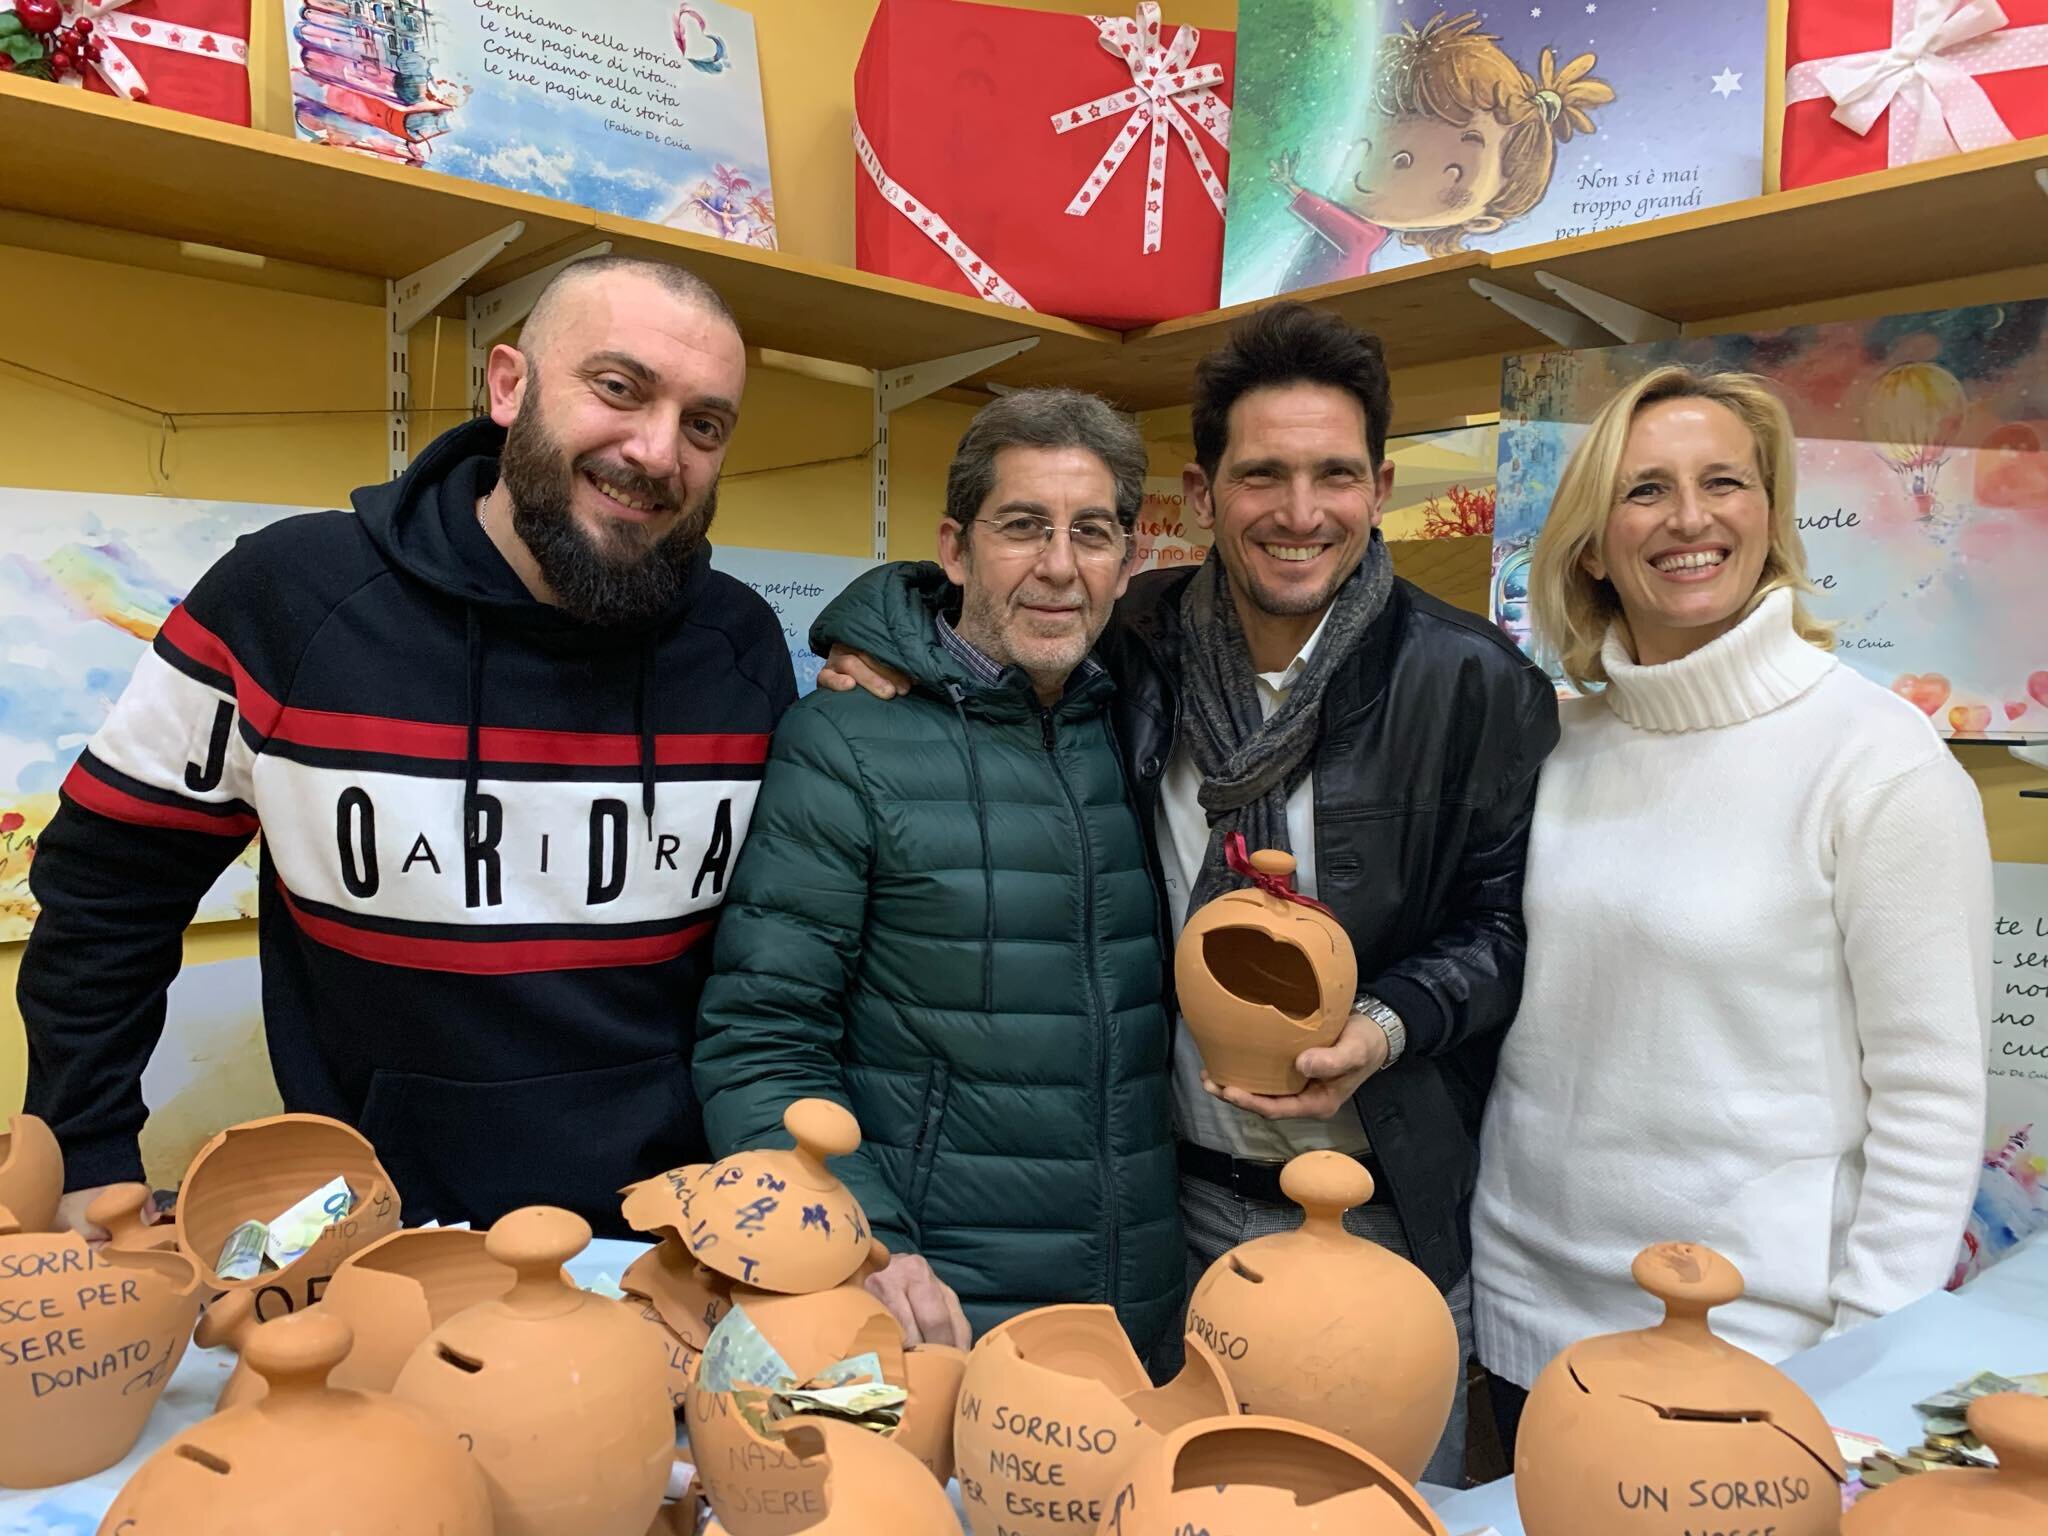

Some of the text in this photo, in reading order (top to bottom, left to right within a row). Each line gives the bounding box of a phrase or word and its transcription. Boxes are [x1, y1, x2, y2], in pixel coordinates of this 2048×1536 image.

[473, 0, 577, 36] Cerchiamo
[581, 30, 628, 53] nella
[480, 14, 678, 89] le sue pagine di vita...
[483, 38, 680, 107] Costruiamo nella vita
[484, 57, 684, 128] le sue pagine di storia
[603, 118, 692, 151] (Fabio De Cuia
[1577, 164, 1700, 190] Non si è mai
[1572, 186, 1703, 222] troppo grandi
[1555, 225, 1585, 240] per
[765, 581, 824, 599] perfetto
[1857, 638, 1894, 649] Cuia
[77, 1280, 141, 1311] PER
[31, 1339, 151, 1398] DONATO
[961, 1389, 1117, 1454] UN SORRISO
[990, 1450, 1066, 1486] NASCE
[1006, 1491, 1102, 1524] ESSERE
[1618, 1476, 1811, 1513] UN SORRISO
